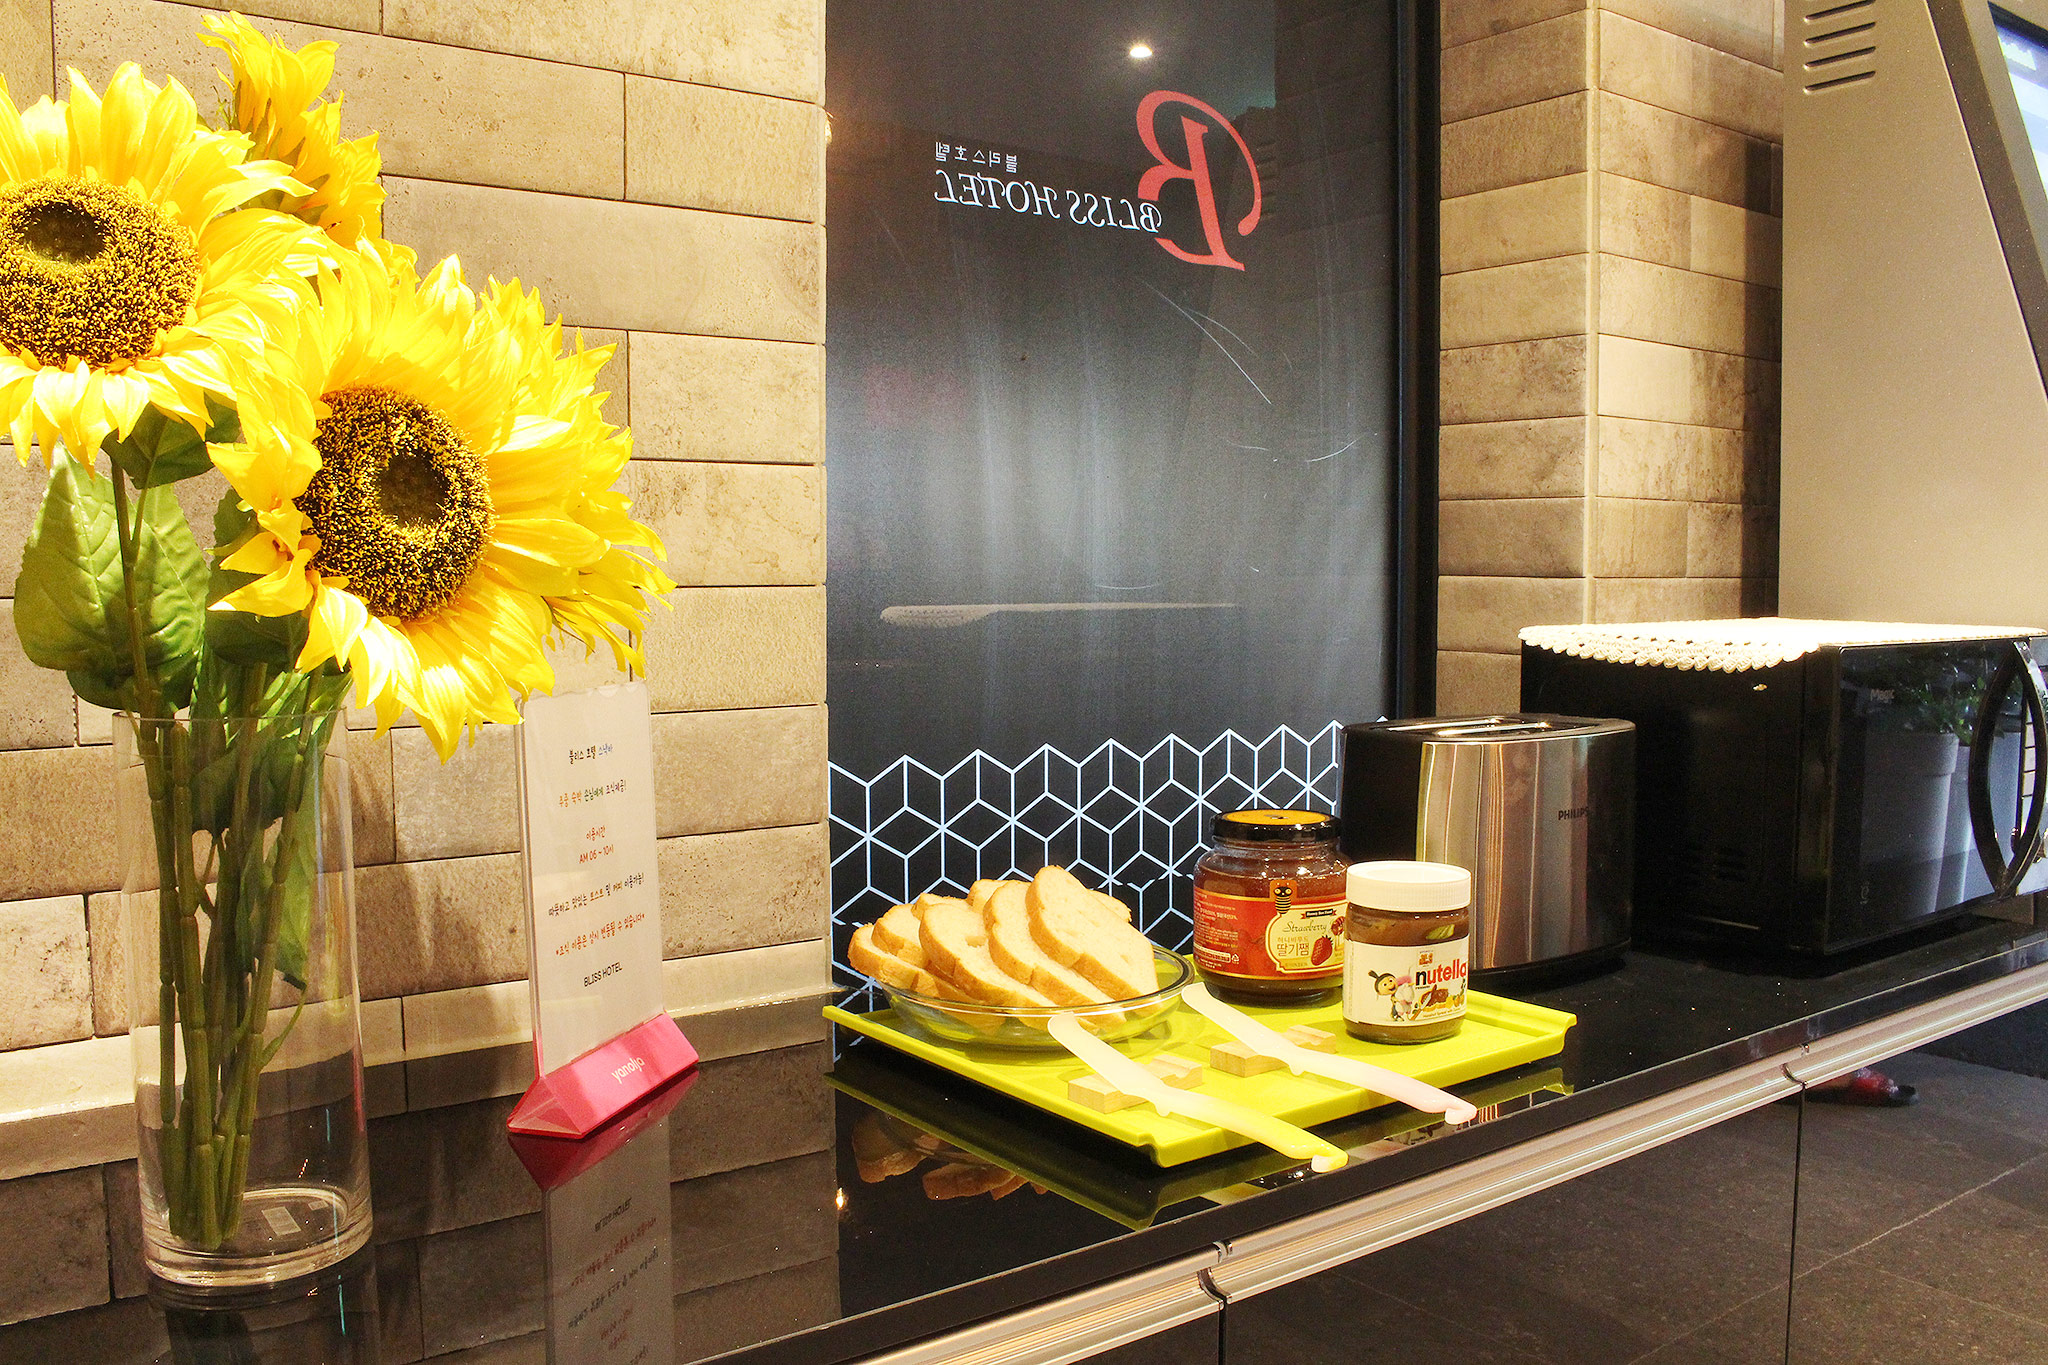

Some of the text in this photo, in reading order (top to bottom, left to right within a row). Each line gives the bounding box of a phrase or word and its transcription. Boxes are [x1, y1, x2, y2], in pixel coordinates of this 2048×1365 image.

[1558, 806, 1589, 821] PHILIPS
[586, 825, 606, 841] 이용시간
[579, 852, 588, 864] AM
[572, 893, 588, 910] 맛있는
[590, 888, 604, 902] 토스트
[617, 920, 622, 931] 수
[1282, 919, 1327, 935] Strawberry
[583, 961, 623, 988] BLISS HOTEL
[1415, 958, 1467, 987] nutella
[611, 1057, 646, 1085] yanolja
